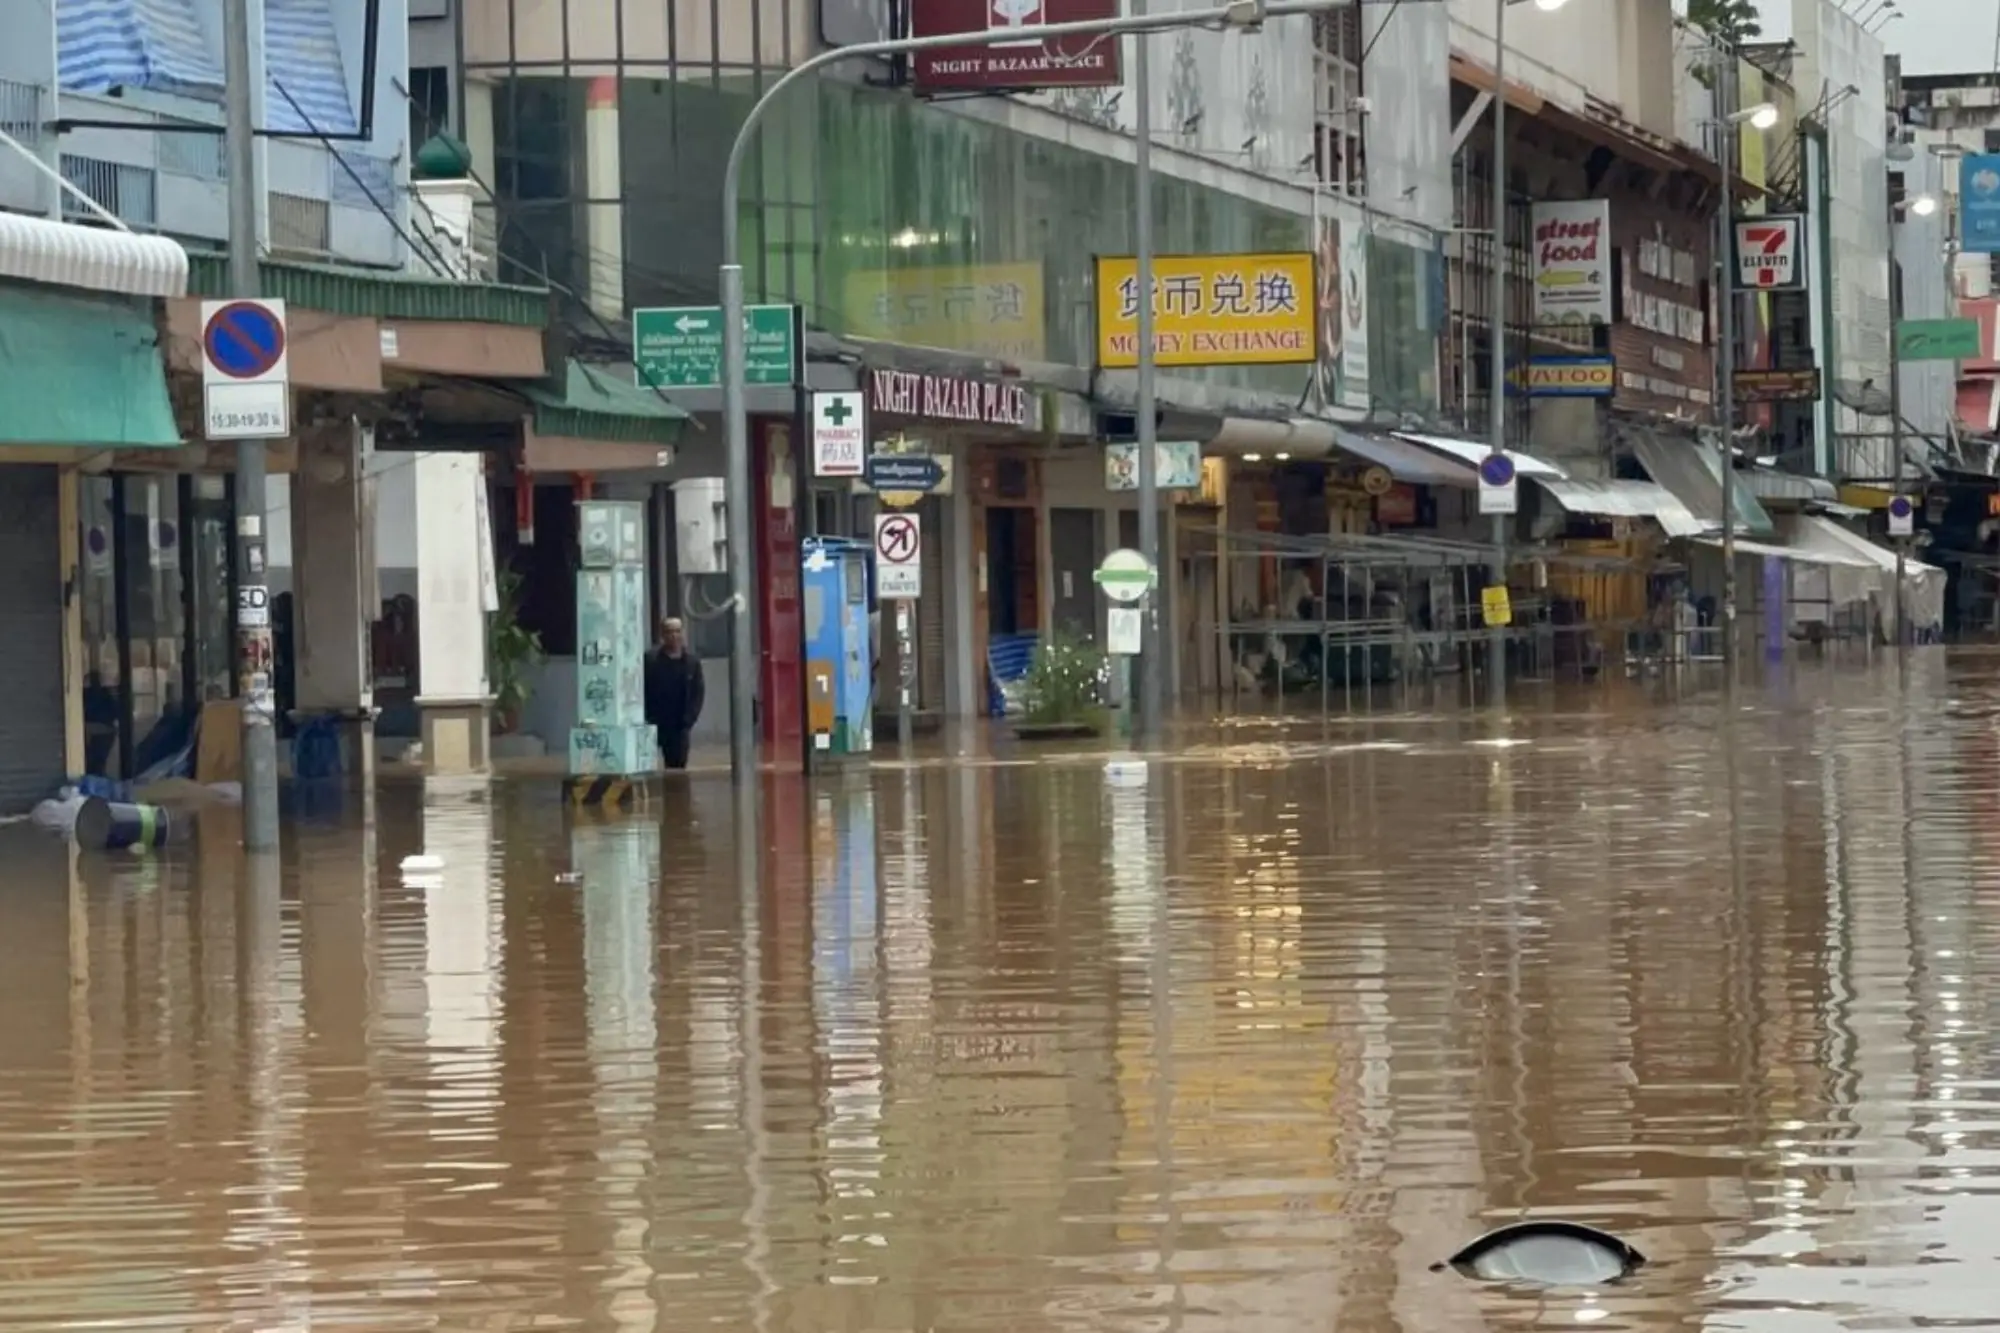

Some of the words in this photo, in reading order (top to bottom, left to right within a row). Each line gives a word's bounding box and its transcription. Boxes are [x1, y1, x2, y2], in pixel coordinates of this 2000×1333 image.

[930, 60, 982, 75] NIGHT
[987, 56, 1050, 72] BAZAAR
[1054, 54, 1105, 69] PLACE
[1541, 237, 1597, 267] food
[1120, 271, 1297, 317] 货币兑换
[1192, 330, 1307, 351] EXCHANGE
[873, 369, 920, 415] NIGHT
[923, 375, 980, 421] BAZAAR
[982, 383, 1026, 425] PLACE
